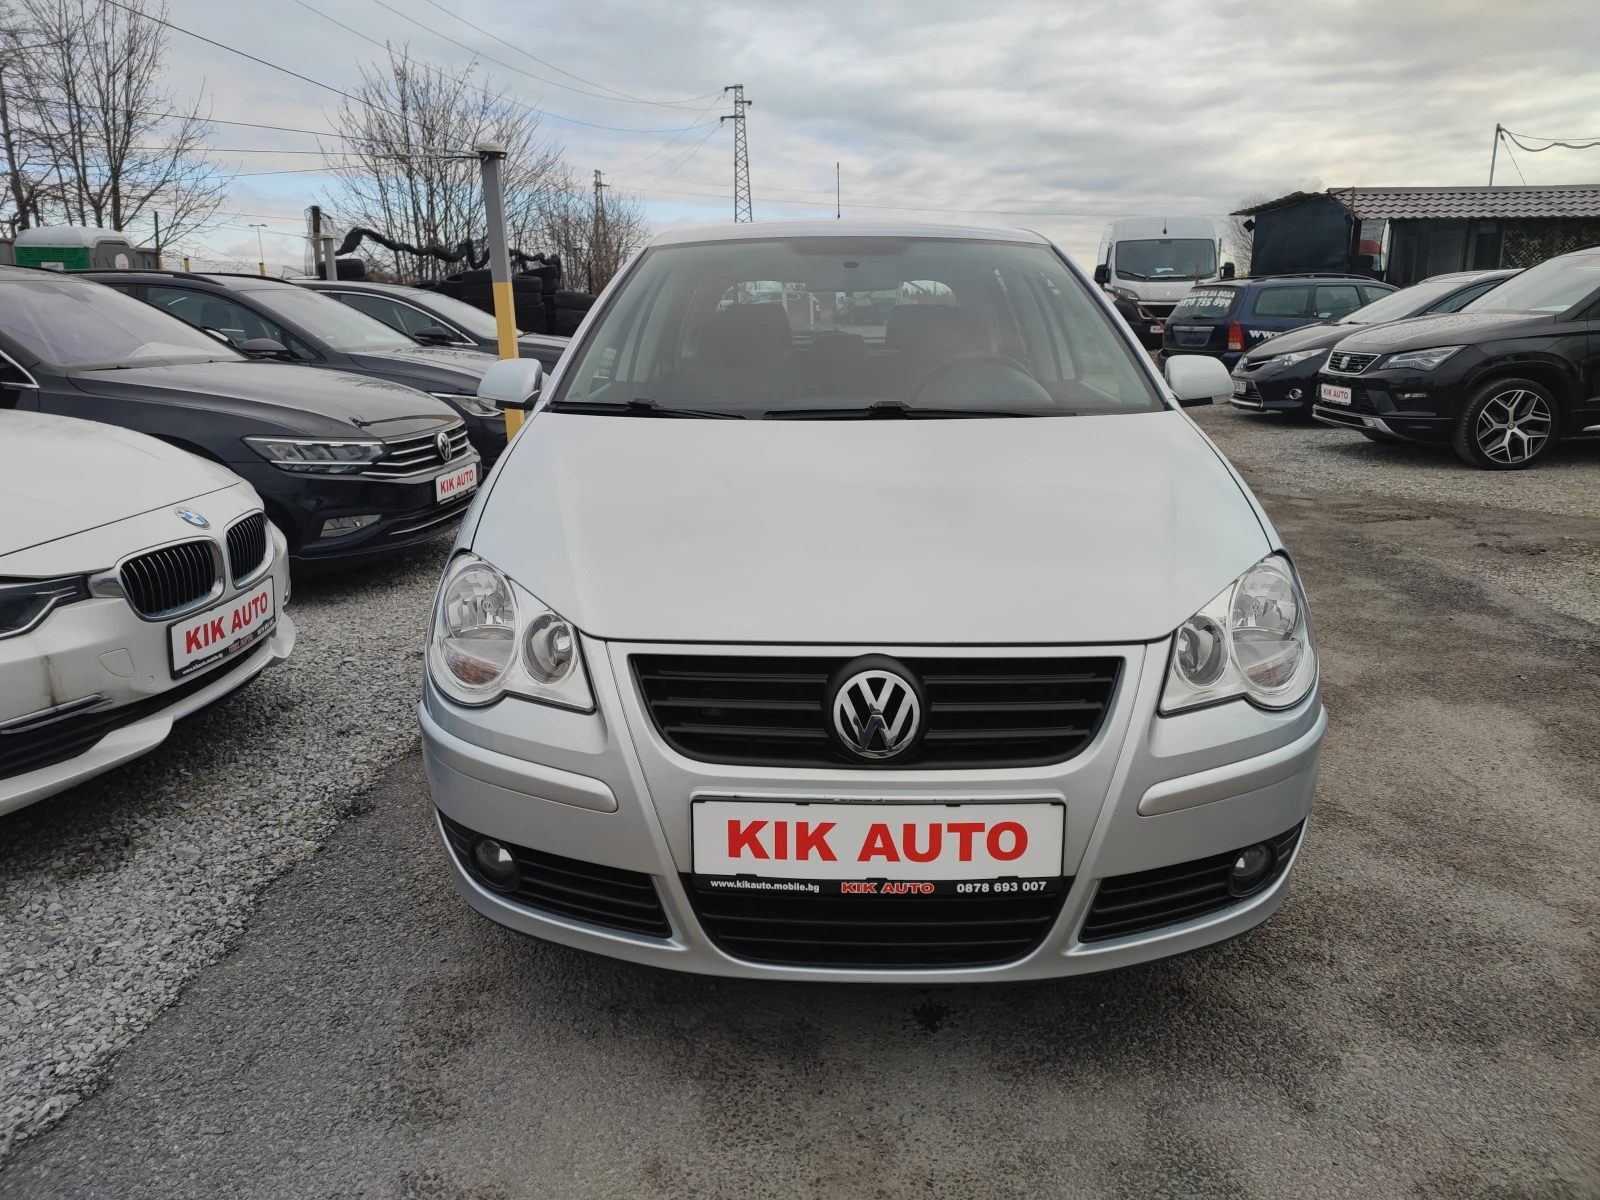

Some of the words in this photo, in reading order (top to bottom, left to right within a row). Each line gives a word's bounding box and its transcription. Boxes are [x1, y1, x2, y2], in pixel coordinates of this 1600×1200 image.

[1196, 297, 1213, 307] 755
[1213, 298, 1232, 307] 899
[1323, 388, 1333, 397] KIK
[1333, 389, 1348, 400] AUTO
[440, 477, 455, 494] KIK
[456, 469, 474, 488] AUTO
[185, 615, 226, 654] KIK
[231, 591, 268, 634] AUTO
[727, 819, 838, 862] KIK
[857, 820, 1028, 863] AUTO
[710, 879, 820, 893] www.kikauto.mobile.bg
[841, 881, 878, 893] KIK
[880, 882, 935, 894] AUTO
[956, 883, 990, 893] 0878
[993, 882, 1018, 892] 693
[1022, 881, 1047, 891] 007
